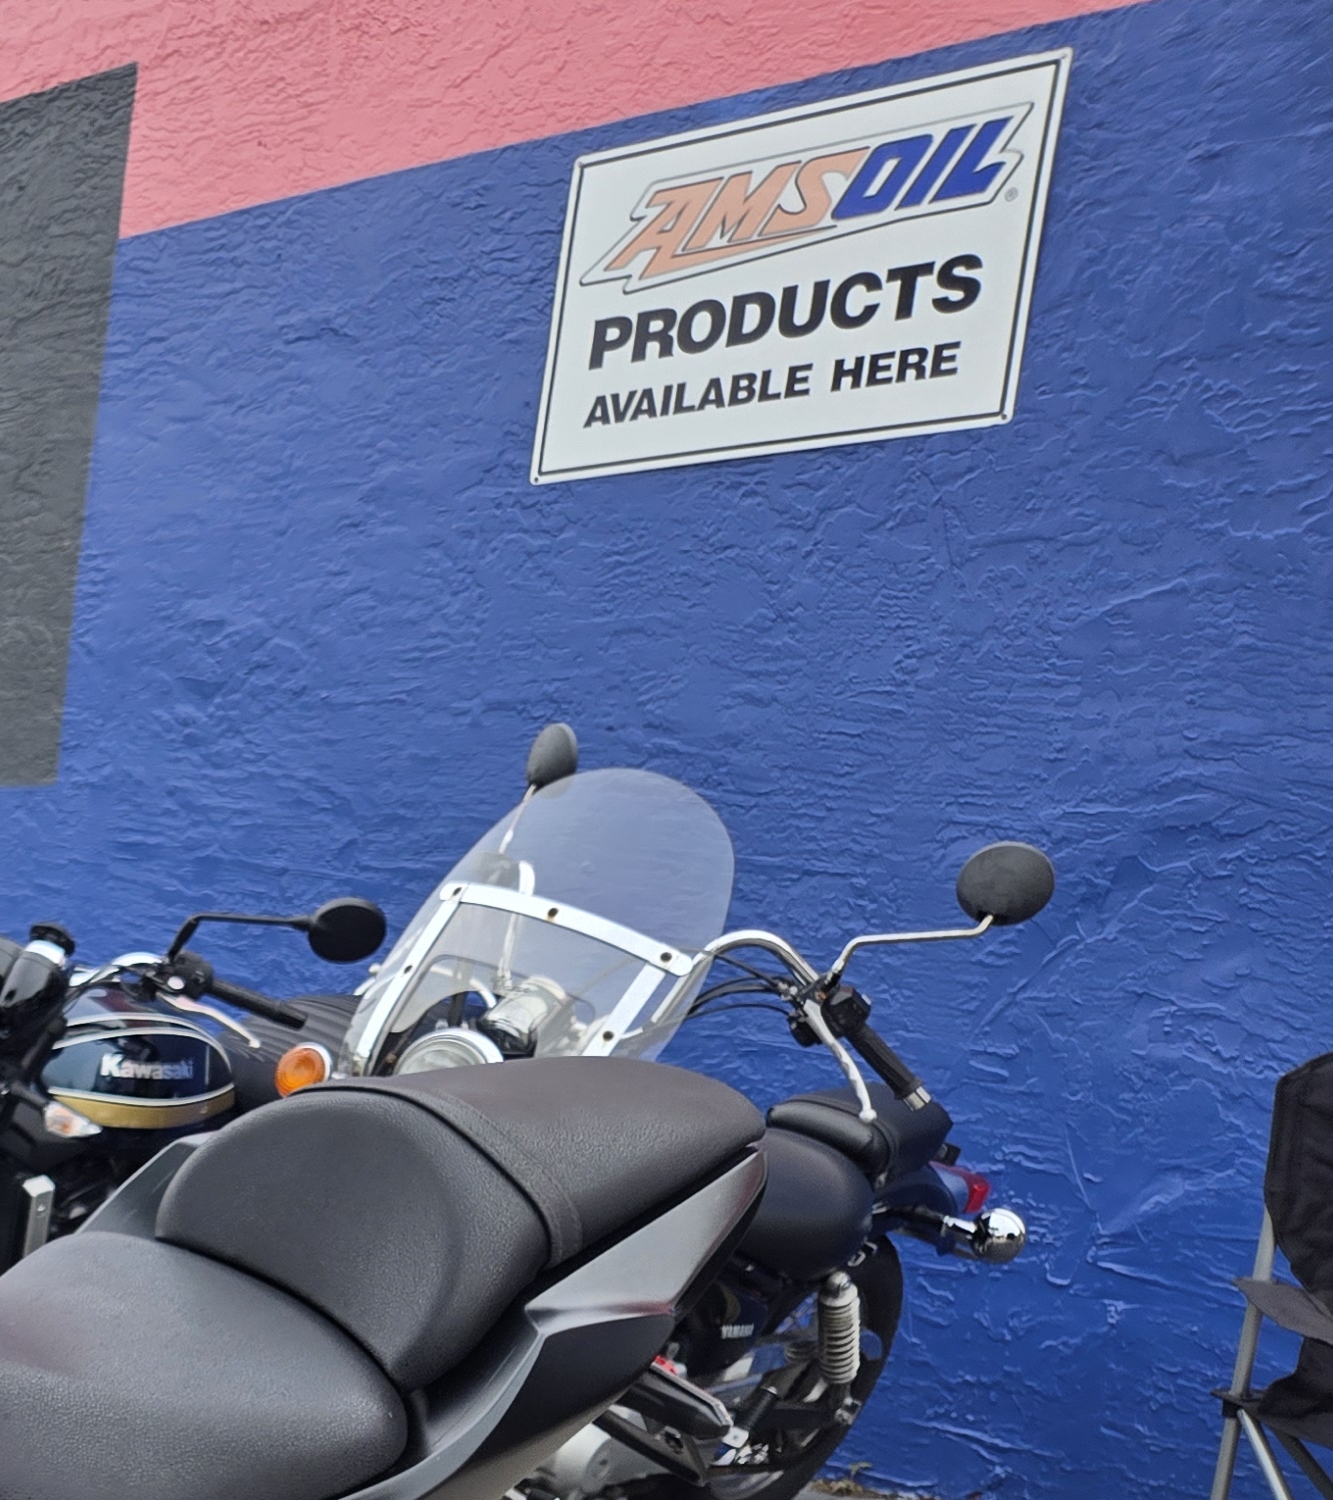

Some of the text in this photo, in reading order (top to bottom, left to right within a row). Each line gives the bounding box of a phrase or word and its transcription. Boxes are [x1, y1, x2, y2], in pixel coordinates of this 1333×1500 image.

[603, 114, 1015, 281] AMSOIL
[587, 253, 985, 372] PRODUCTS
[582, 340, 962, 429] AVAILABLE HERE
[100, 1052, 195, 1081] Kawasaki
